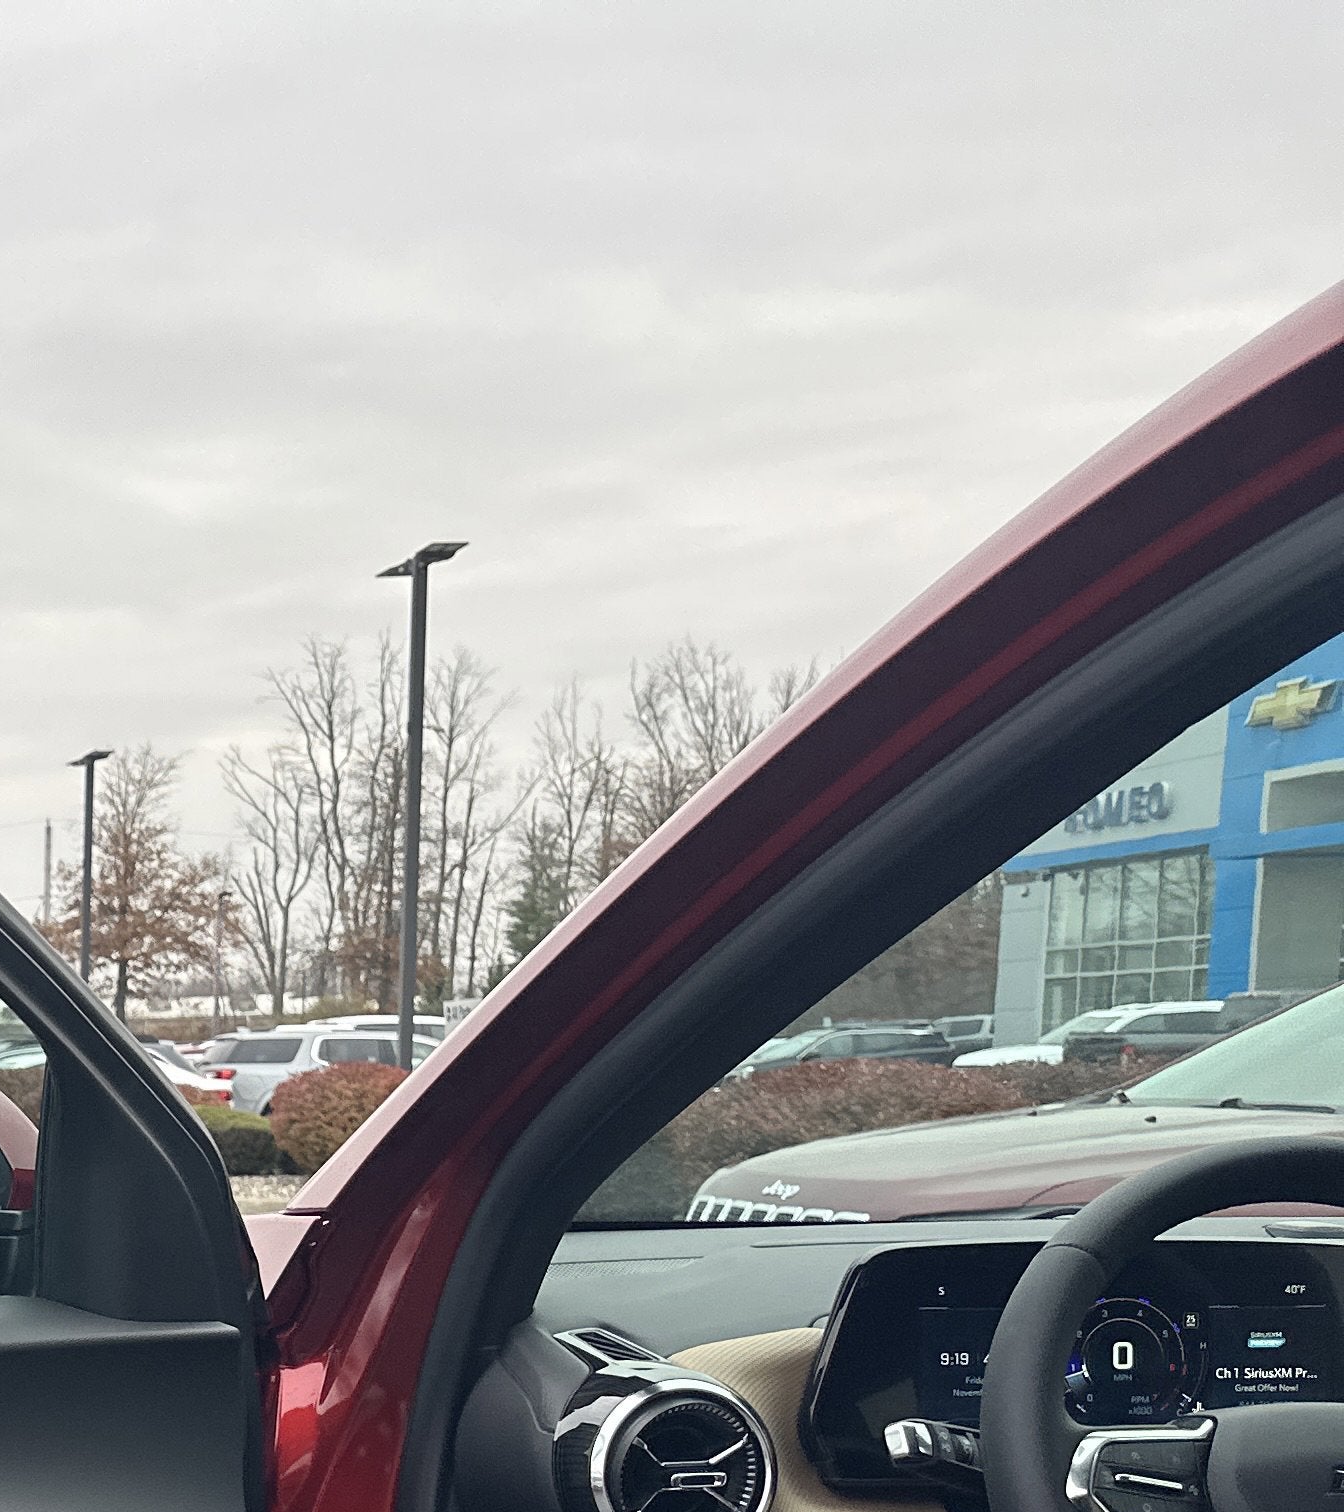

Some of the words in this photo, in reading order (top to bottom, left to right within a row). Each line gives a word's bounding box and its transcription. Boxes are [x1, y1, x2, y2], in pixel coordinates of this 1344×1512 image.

[940, 1352, 970, 1366] 9:19
[1112, 1341, 1134, 1370] 0
[1215, 1367, 1232, 1379] Ch
[1233, 1367, 1239, 1379] 1
[1243, 1367, 1293, 1379] SiriusXM
[1234, 1383, 1257, 1393] Great
